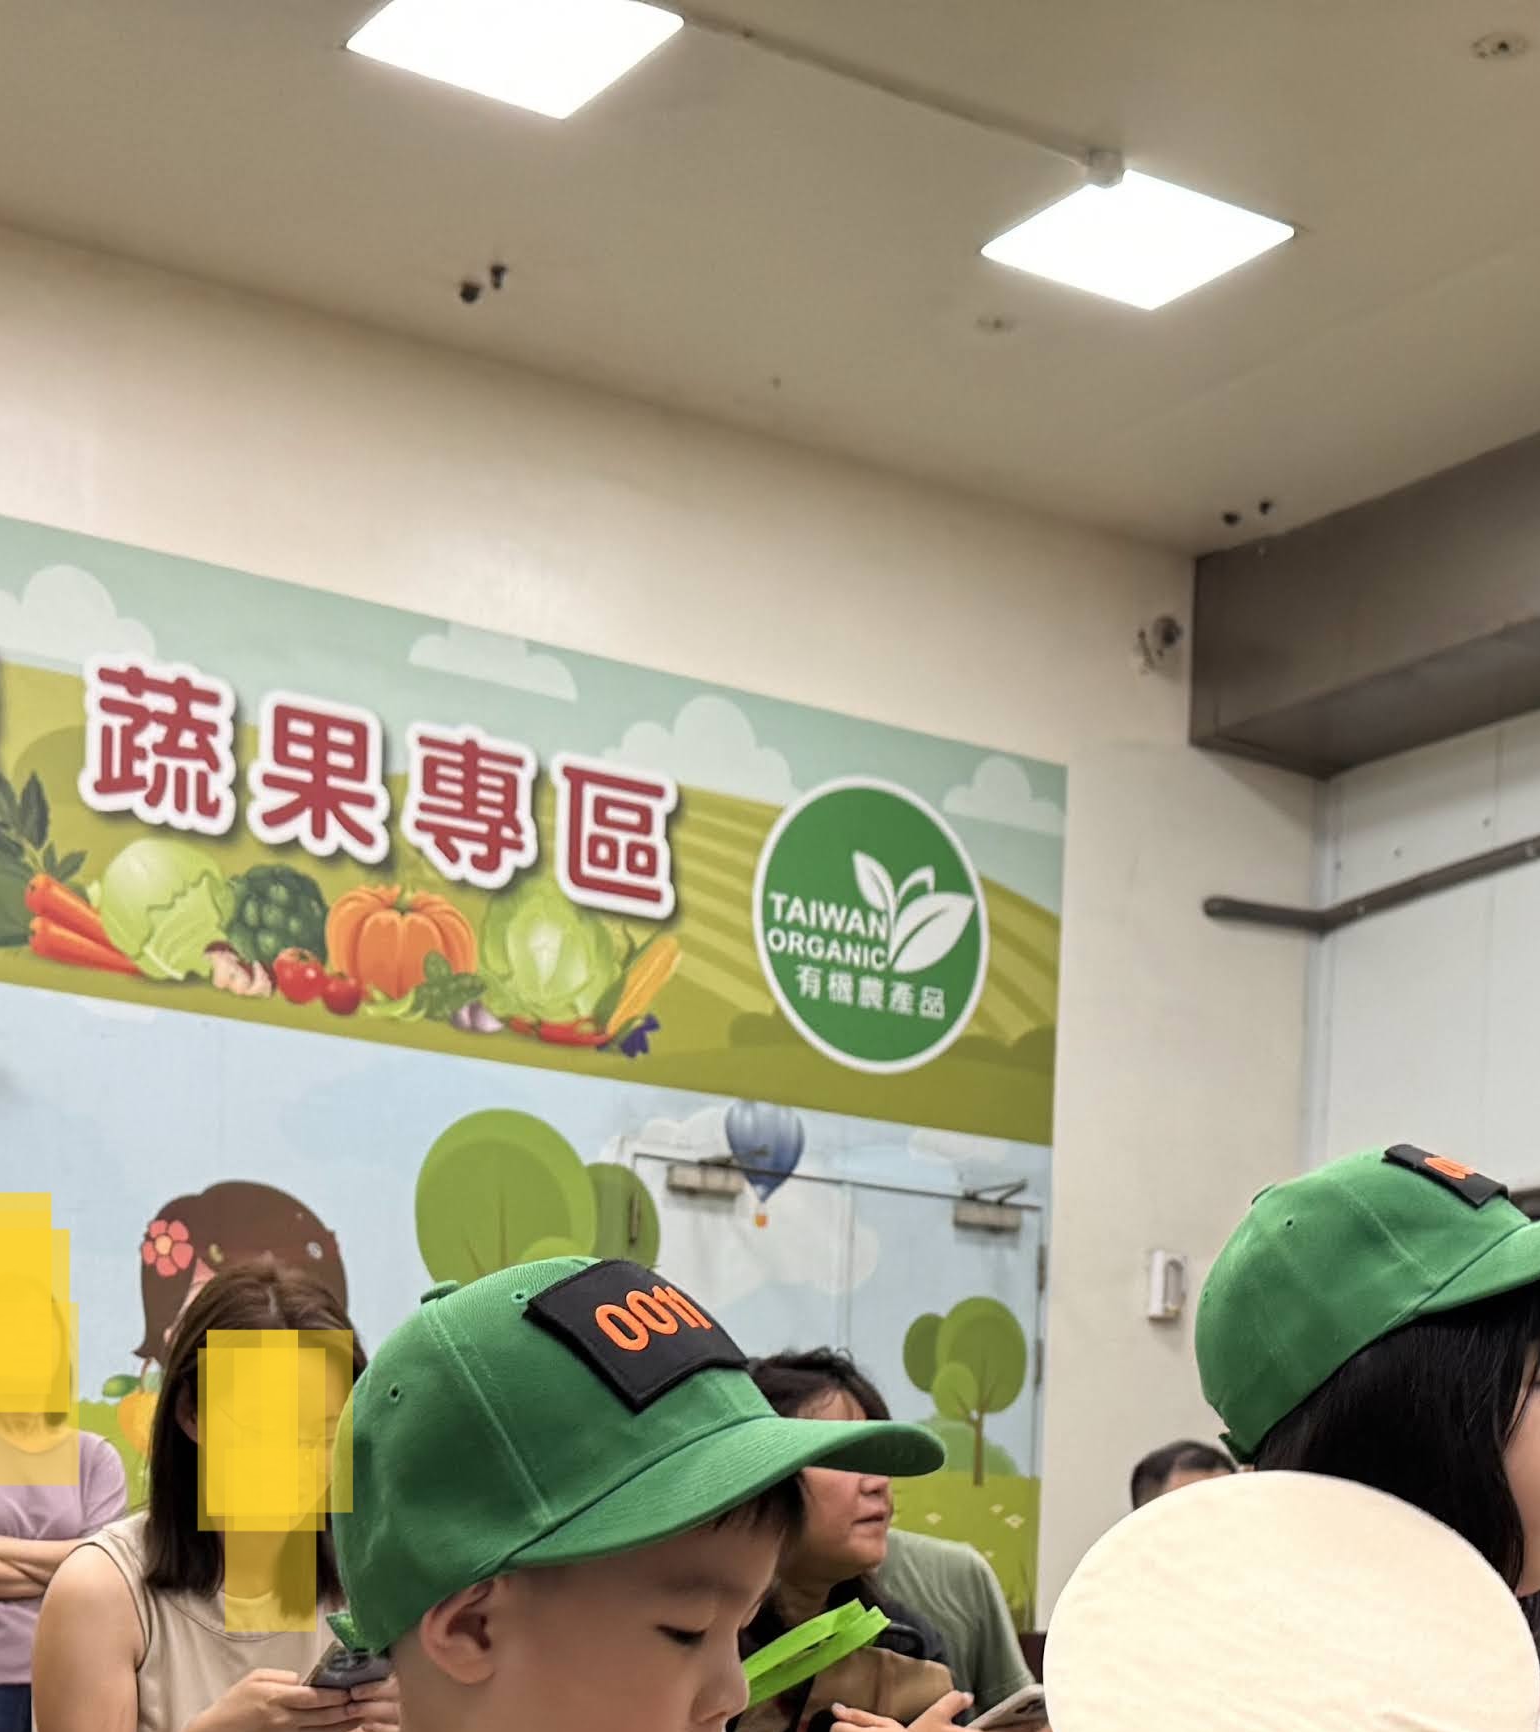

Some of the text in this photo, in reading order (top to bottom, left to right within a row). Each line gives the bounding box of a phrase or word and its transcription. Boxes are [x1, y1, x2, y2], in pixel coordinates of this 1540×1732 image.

[94, 664, 666, 903] 蔬果專區
[768, 892, 888, 941] TAIWAN
[767, 927, 888, 971] ORGANIC
[796, 964, 946, 1020] 有機農產品
